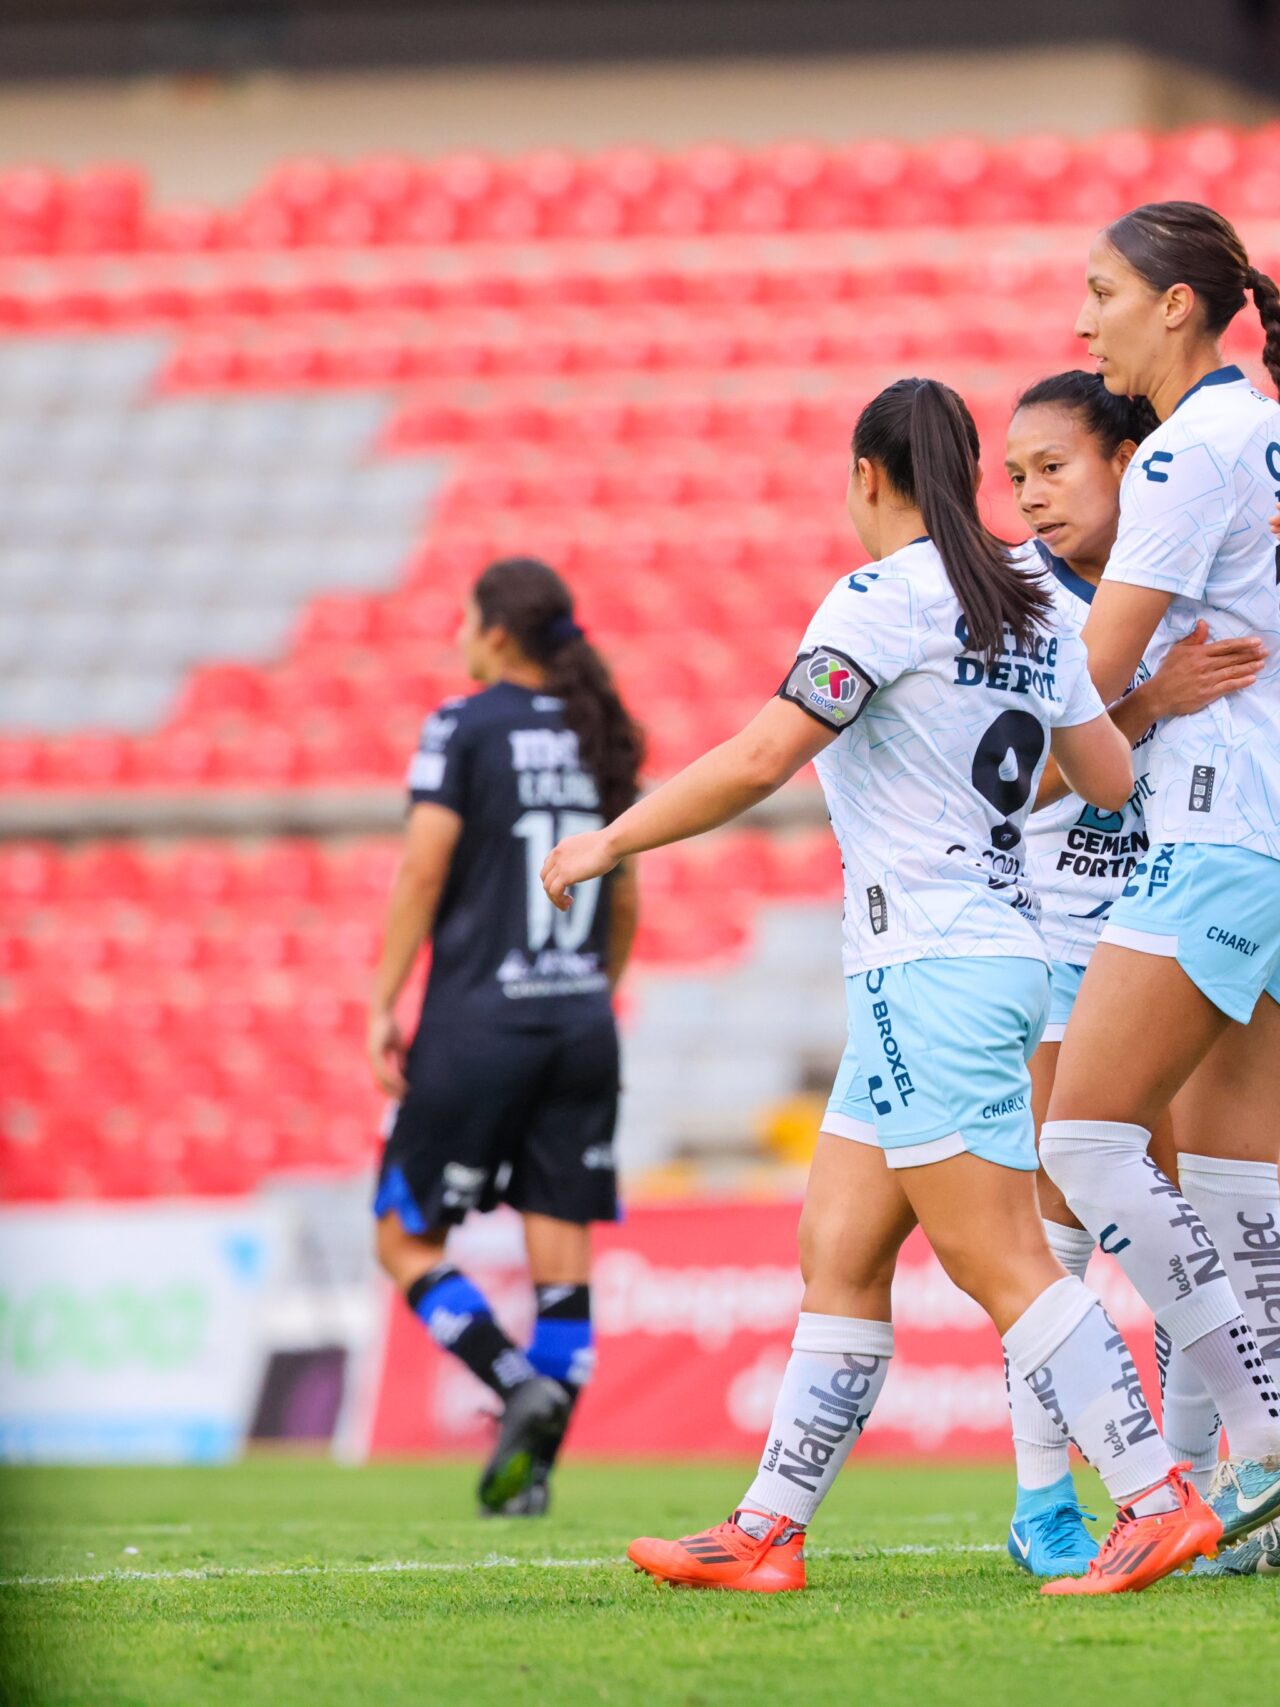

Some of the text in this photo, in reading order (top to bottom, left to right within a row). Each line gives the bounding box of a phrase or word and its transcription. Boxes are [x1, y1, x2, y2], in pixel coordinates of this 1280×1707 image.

[954, 656, 1056, 701] DEPOT
[809, 691, 837, 712] BBVA
[1067, 829, 1150, 856] CEMEN
[1056, 851, 1138, 877] FORTA
[1147, 843, 1175, 897] XEL
[1206, 926, 1260, 957] CHARLY
[872, 1000, 916, 1107] BROXEL
[983, 1095, 1027, 1119] CHARLY
[1167, 1254, 1193, 1301] leche
[777, 1353, 880, 1493] Natulec
[1103, 1419, 1126, 1459] leche
[763, 1438, 783, 1472] leche
